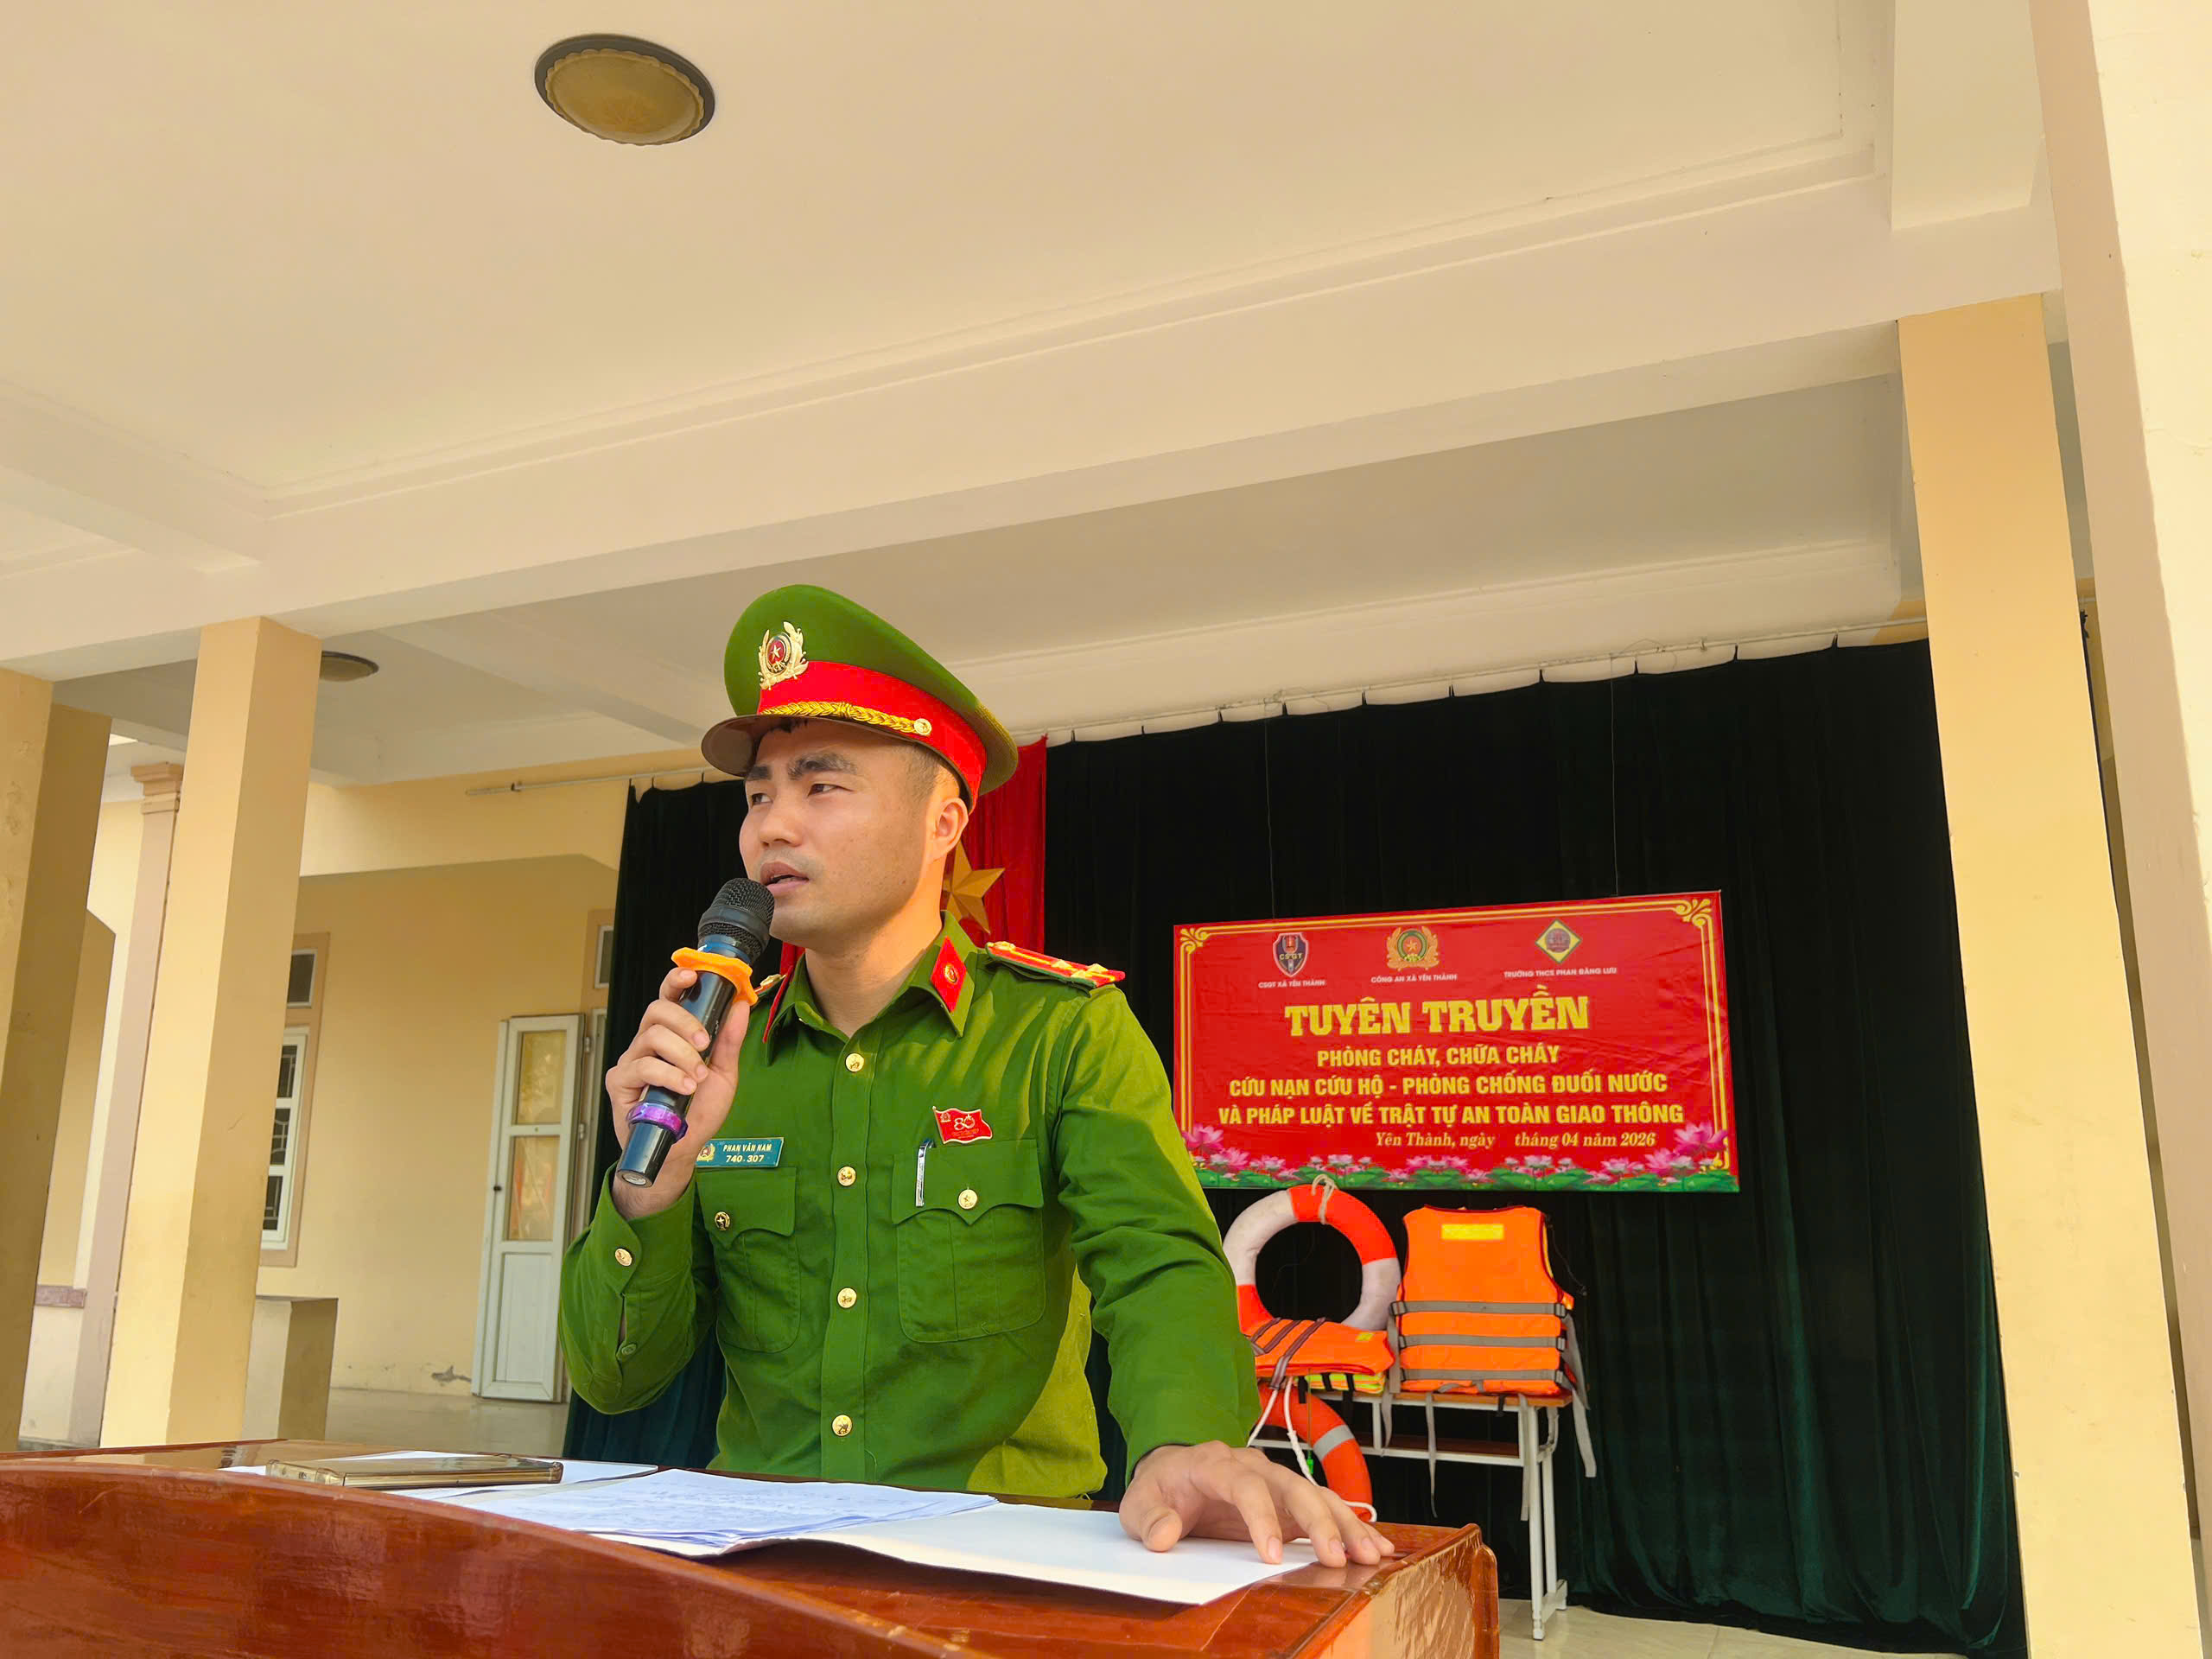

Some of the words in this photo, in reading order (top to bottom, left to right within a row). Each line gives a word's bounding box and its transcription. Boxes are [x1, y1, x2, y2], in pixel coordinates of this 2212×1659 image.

[1279, 952, 1302, 961] CSGT
[1370, 975, 1392, 983] CÔNG
[1407, 974, 1416, 982] XÃ
[1417, 973, 1432, 982] YÊN
[1433, 973, 1458, 982] THÀNH
[1503, 969, 1535, 978] TRƯỜNG
[1288, 979, 1301, 988] YÊN
[1302, 978, 1325, 987] THÀNH
[1284, 996, 1411, 1037] TUYÊN
[1422, 984, 1590, 1034] TRUYỀN
[1317, 1046, 1382, 1067] PHÒNG
[1387, 1045, 1440, 1068] CHÁY,
[1446, 1044, 1500, 1065] CHỮA
[1506, 1042, 1560, 1065] CHÁY
[1229, 1077, 1266, 1096] CỨU
[1270, 1078, 1310, 1100] NẠN
[1314, 1075, 1352, 1096] CỨU
[1358, 1074, 1383, 1099] HỘ
[1402, 1073, 1470, 1095] PHÒNG
[1476, 1070, 1546, 1094] CHỐNG
[1551, 1068, 1601, 1093] ĐUỐI
[1608, 1070, 1668, 1093] NƯỚC
[1218, 1104, 1242, 1124] VÀ
[1246, 1103, 1294, 1124] PHÁP
[1300, 1103, 1344, 1128] LUẬT
[1378, 1103, 1426, 1128] TRẬT
[1431, 1104, 1458, 1128] TỰ
[1461, 1105, 1490, 1124] AN
[1495, 1102, 1550, 1124] TOÀN
[1555, 1104, 1605, 1124] GIAO
[1611, 1101, 1684, 1124] THÔNG
[742, 1142, 756, 1152] VĂN
[757, 1143, 772, 1152] NAM
[1376, 1132, 1402, 1147] Yên
[1406, 1132, 1456, 1148] Thành,
[1459, 1133, 1496, 1149] ngày
[1515, 1132, 1559, 1149] tháng
[1561, 1133, 1578, 1147] 04
[1583, 1134, 1618, 1147] năm
[1620, 1132, 1656, 1147] 2026
